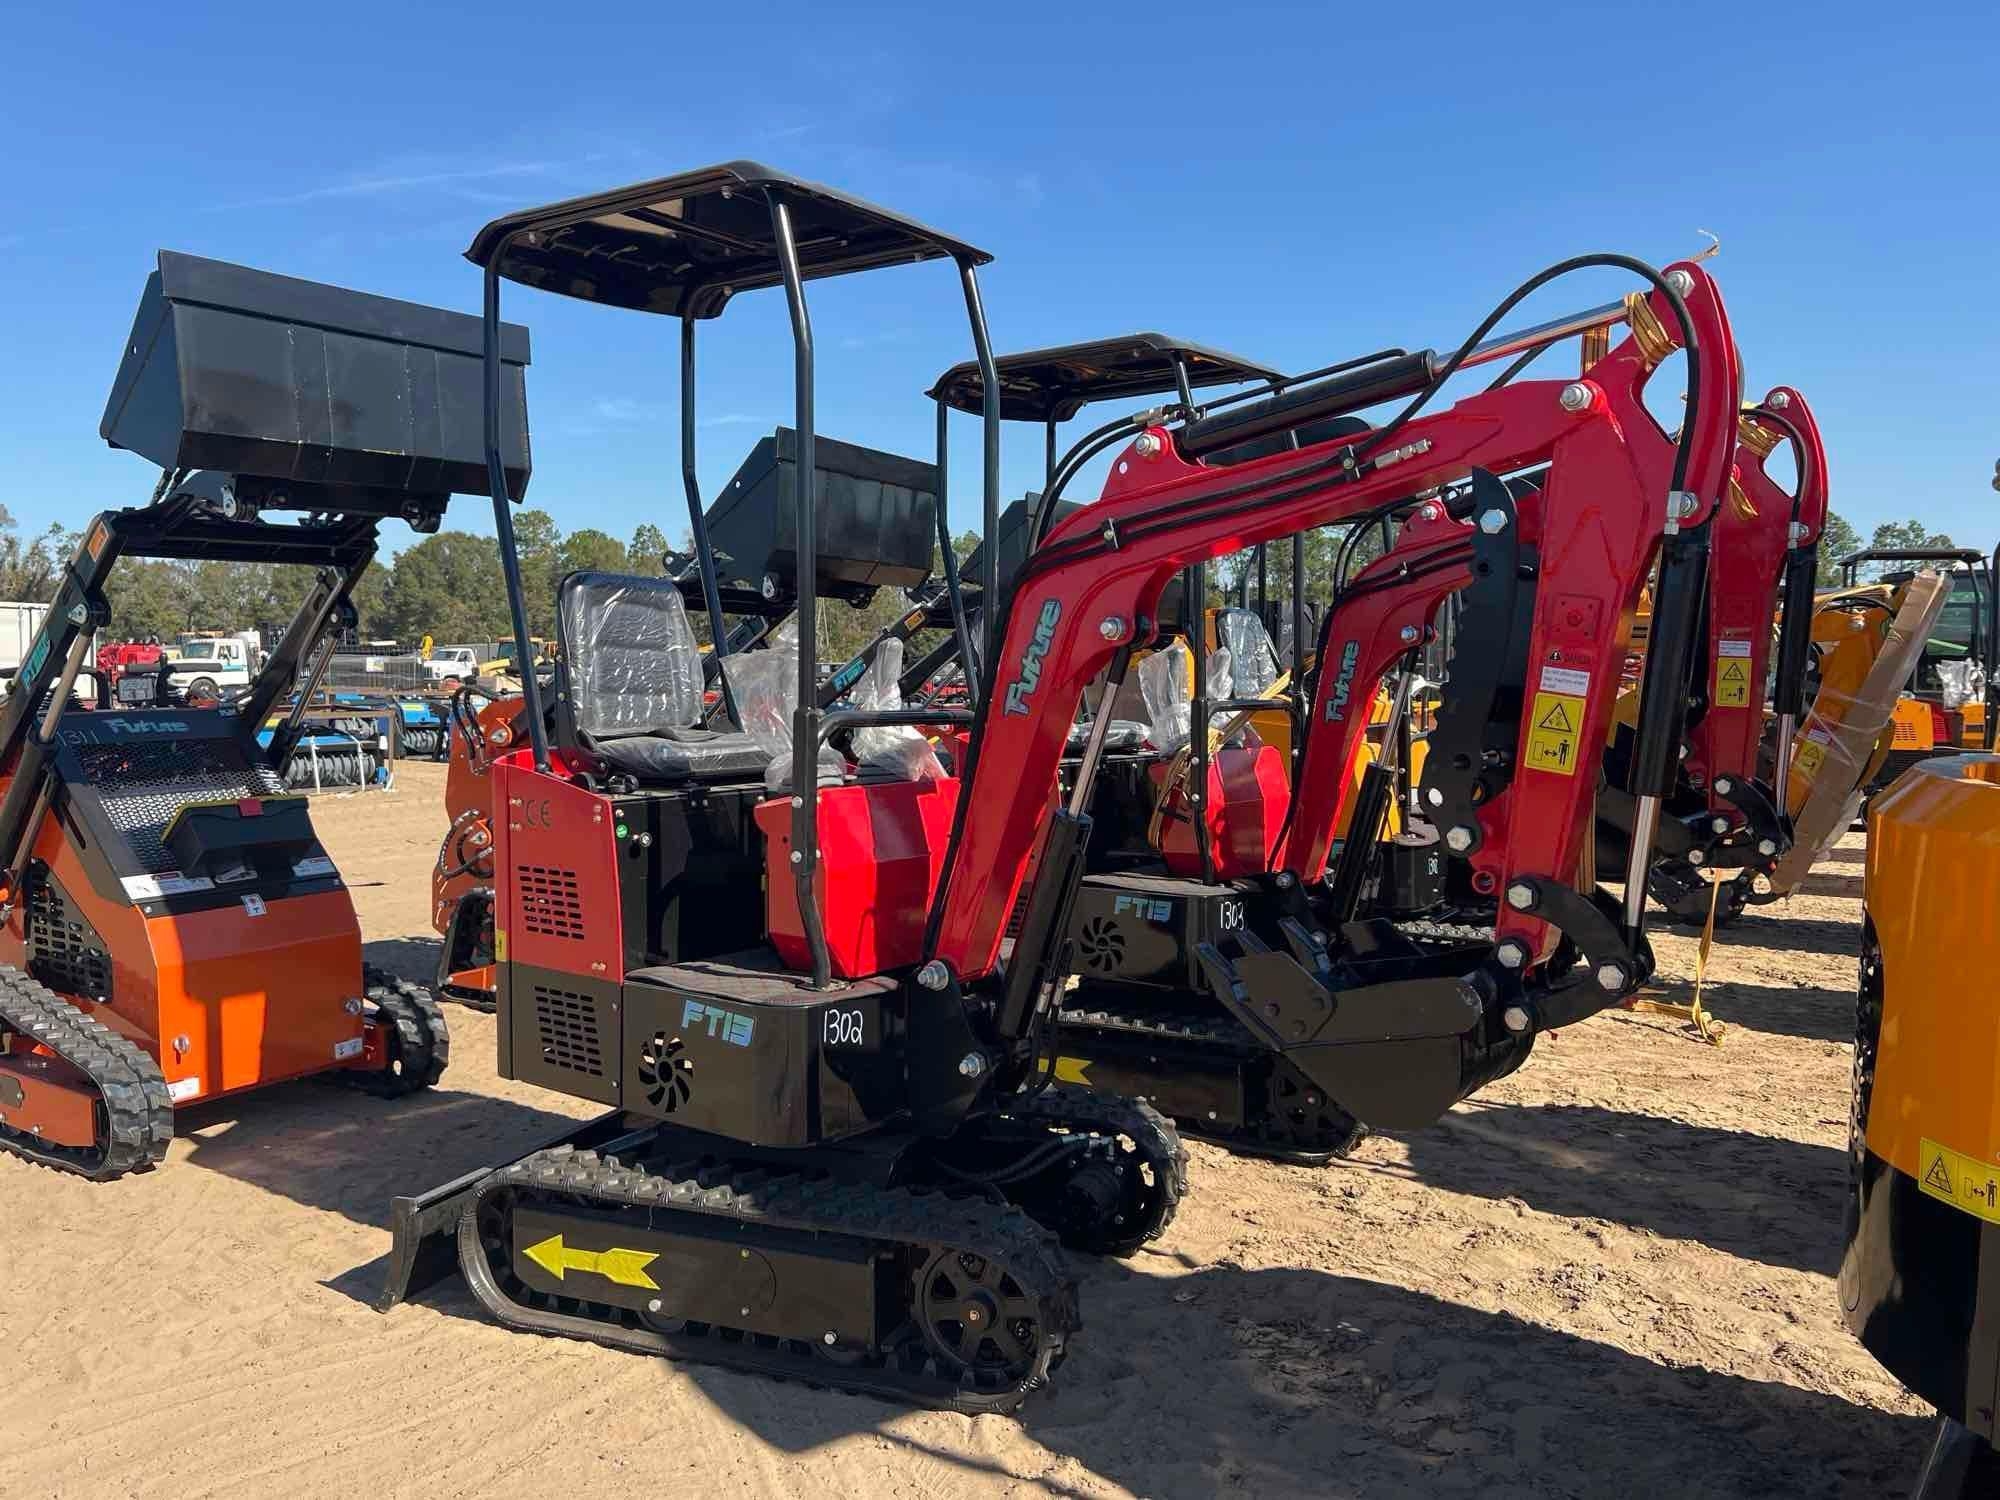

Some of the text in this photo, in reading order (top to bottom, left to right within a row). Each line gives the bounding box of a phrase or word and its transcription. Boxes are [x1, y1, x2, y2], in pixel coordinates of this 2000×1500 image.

[1003, 598, 1062, 717] Future
[1325, 640, 1360, 723] Future
[102, 717, 191, 734] Future
[526, 798, 553, 828] CE
[1219, 900, 1245, 931] 1303
[681, 999, 754, 1047] FT13
[823, 1008, 864, 1046] 1302
